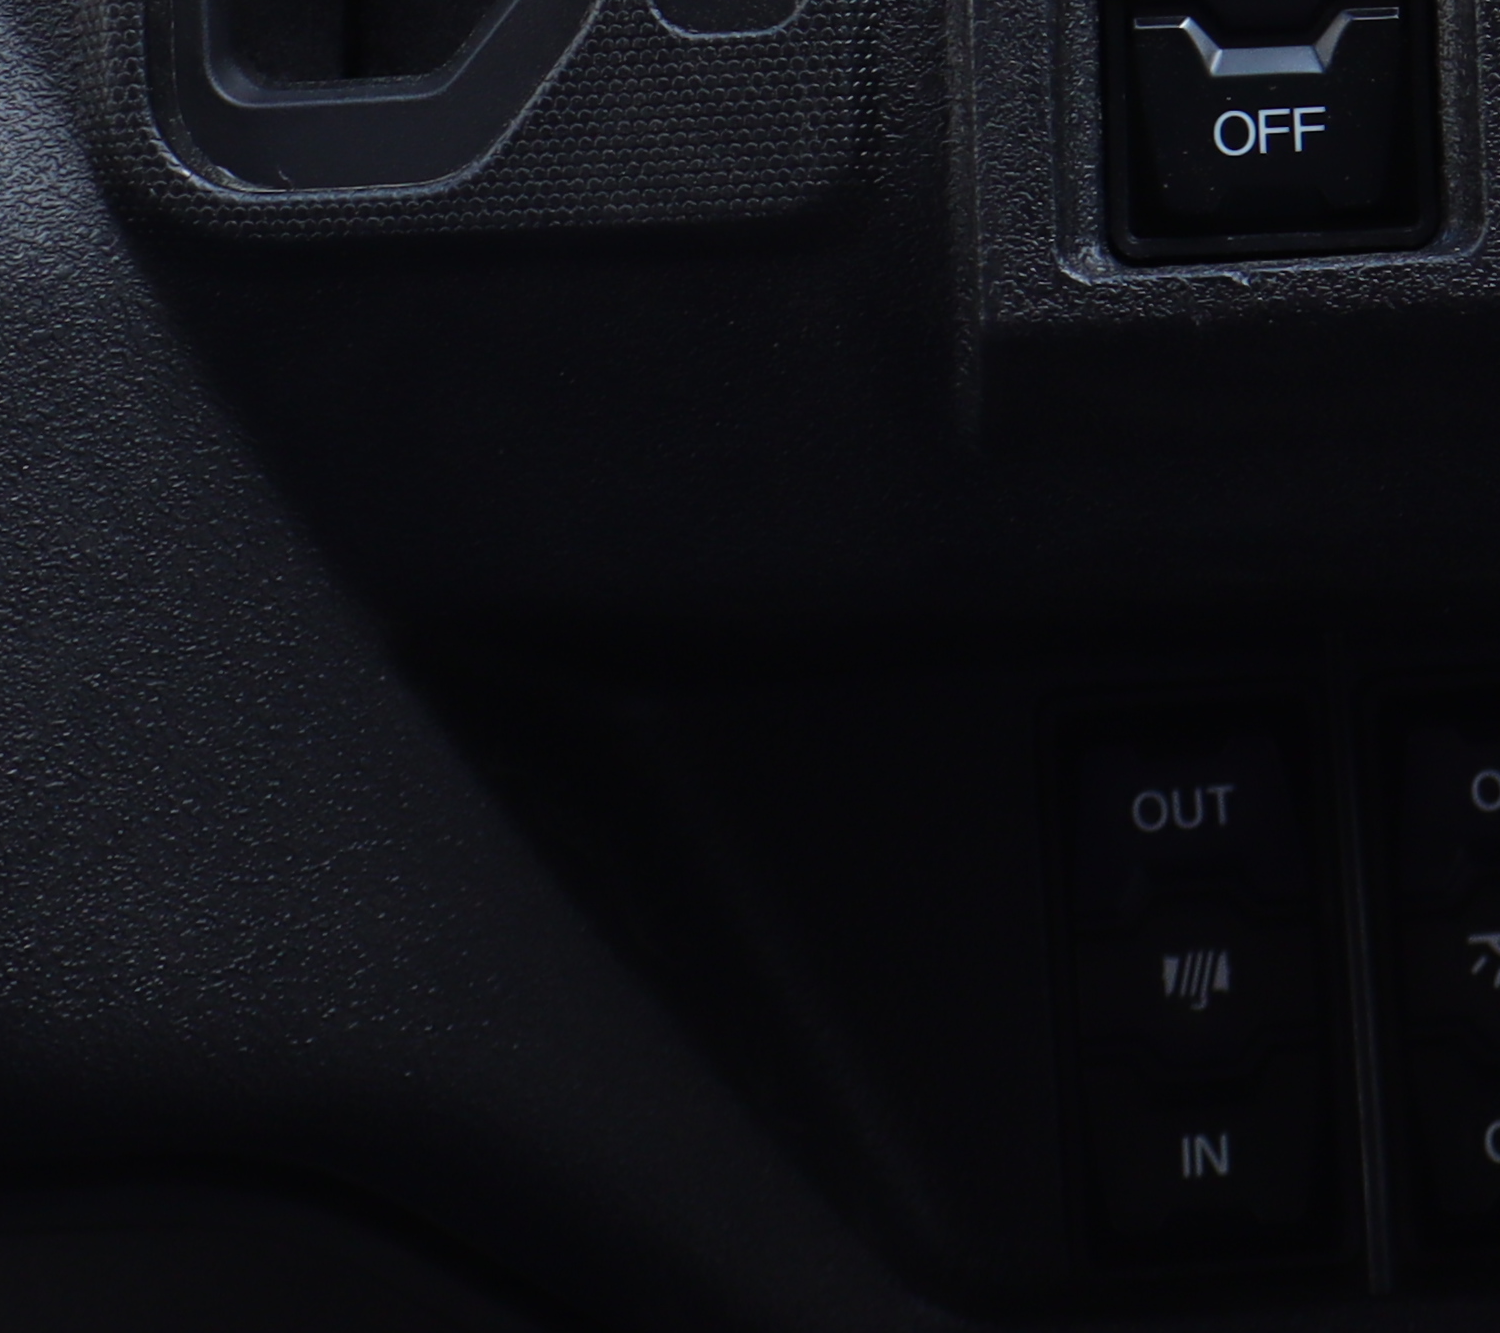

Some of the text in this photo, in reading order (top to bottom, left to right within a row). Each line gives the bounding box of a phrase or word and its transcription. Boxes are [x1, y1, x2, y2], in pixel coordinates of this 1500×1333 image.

[1213, 107, 1326, 157] OFF
[1131, 783, 1236, 832] OUT
[1180, 1131, 1231, 1179] IN
